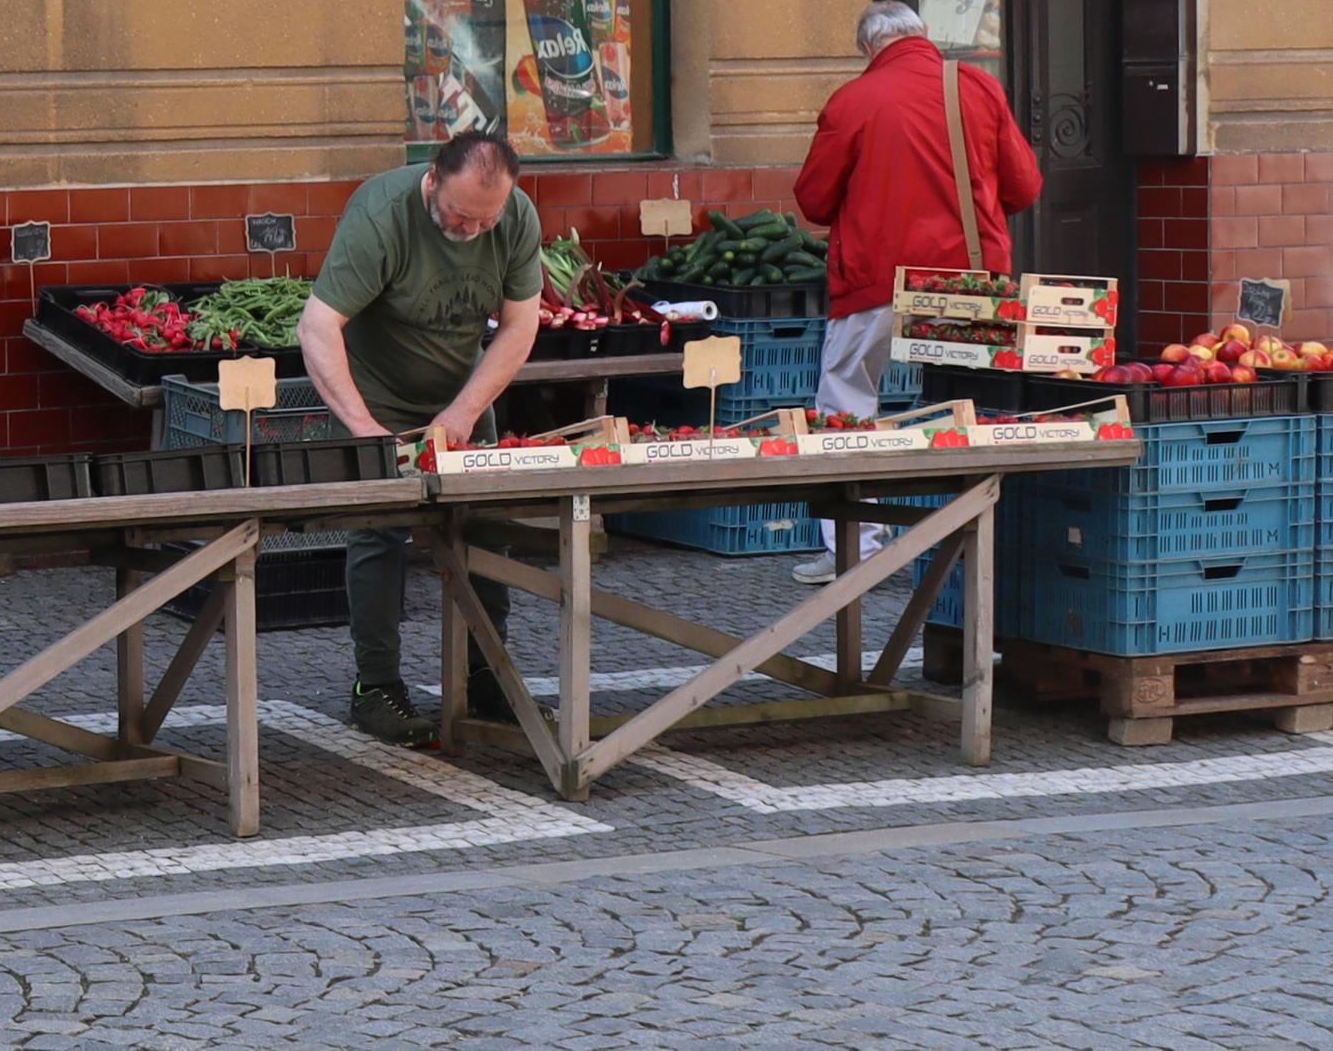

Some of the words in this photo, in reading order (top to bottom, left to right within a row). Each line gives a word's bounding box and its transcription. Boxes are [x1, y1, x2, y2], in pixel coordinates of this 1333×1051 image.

[912, 295, 948, 309] GOLD
[949, 301, 983, 312] VICTORY
[1032, 305, 1061, 317] GOLD
[910, 343, 944, 357] GOLD
[945, 349, 979, 361] VICTORY
[1029, 354, 1058, 365] GOLD
[993, 426, 1037, 441] GOLD
[1039, 428, 1080, 439] VICTORY
[822, 435, 869, 450] GOLD
[871, 437, 913, 448] VICTORY
[646, 443, 693, 458] GOLD
[695, 444, 740, 456] VICTORY
[462, 453, 511, 468] GOLD
[514, 454, 560, 465] VICTORY
